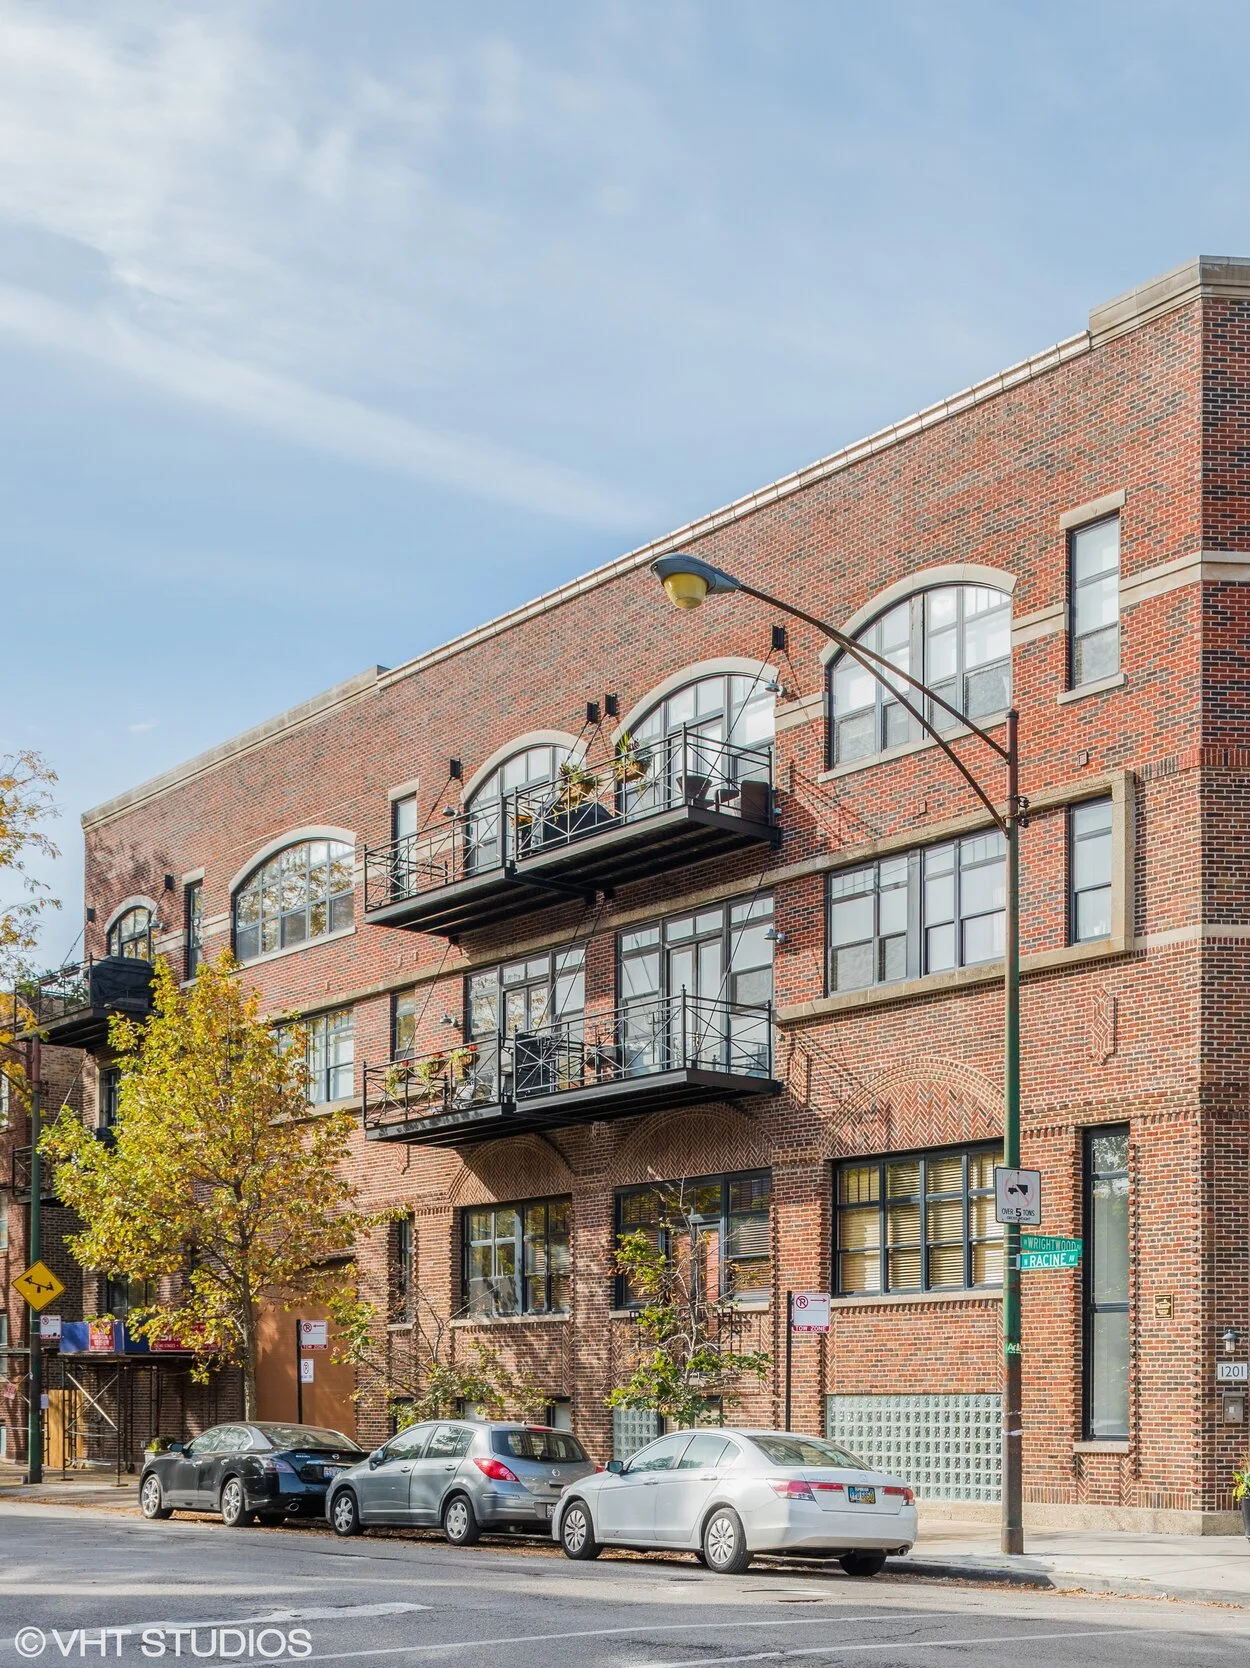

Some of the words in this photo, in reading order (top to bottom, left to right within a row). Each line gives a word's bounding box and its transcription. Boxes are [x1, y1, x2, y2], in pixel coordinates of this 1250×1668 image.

[1001, 1207, 1014, 1215] OVER
[1015, 1207, 1022, 1217] 5
[1027, 1236, 1077, 1251] WRIGHTWOOD
[1029, 1253, 1067, 1268] RACINE
[1221, 1365, 1244, 1377] 1201
